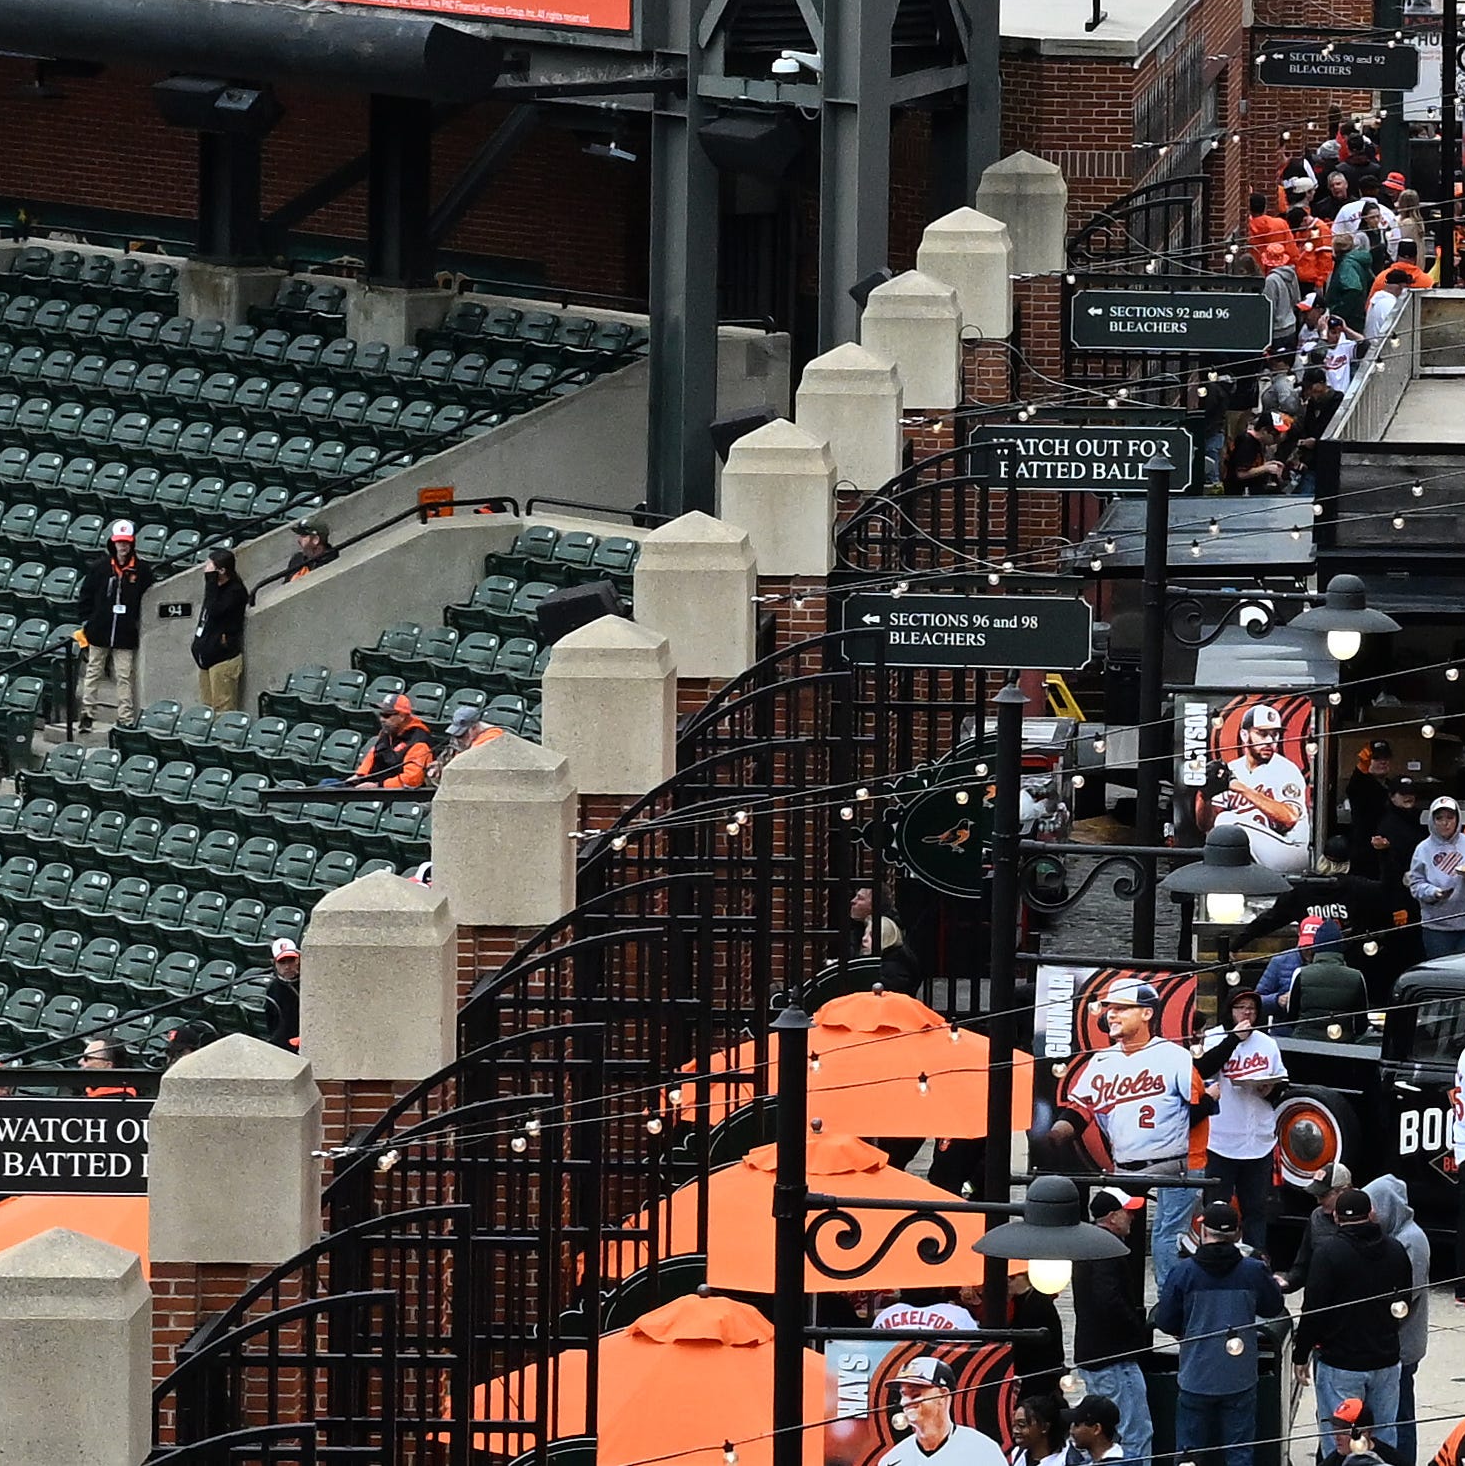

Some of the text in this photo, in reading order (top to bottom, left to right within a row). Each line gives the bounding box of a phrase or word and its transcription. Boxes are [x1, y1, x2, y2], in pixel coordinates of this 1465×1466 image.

[1289, 52, 1386, 66] SECTIONS 90 and 92
[1289, 63, 1351, 76] BLEACHERS
[1108, 305, 1231, 321] SECTIONS 92 and 96
[1108, 320, 1188, 335] BLEACHERS
[1075, 439, 1123, 457] OUT
[1128, 440, 1172, 458] FOR
[1091, 462, 1149, 481] BALL
[168, 605, 182, 616] 94
[889, 612, 1038, 630] SECTIONS 96 and 98
[888, 631, 986, 647] BLEACHERS
[1044, 974, 1076, 1059] GUNNAR
[1091, 1068, 1166, 1113] Orioles
[1138, 1105, 1156, 1129] 2
[1, 1151, 127, 1180] BATTED
[837, 1353, 869, 1420] HAYS
